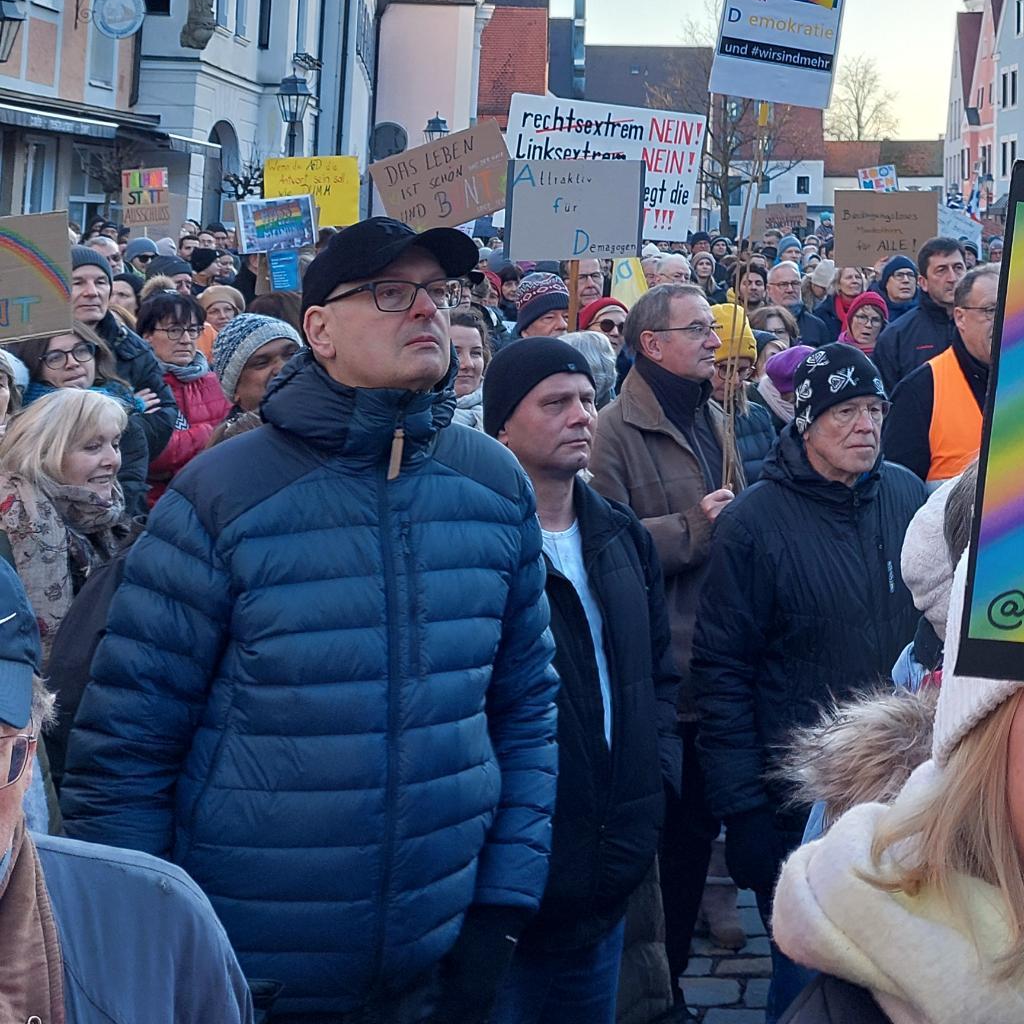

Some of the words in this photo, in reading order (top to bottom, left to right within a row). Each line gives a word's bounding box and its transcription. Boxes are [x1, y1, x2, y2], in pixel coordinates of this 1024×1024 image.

[724, 42, 748, 56] und
[751, 46, 830, 70] #wirsindmehr
[521, 106, 644, 141] rechtsextrem
[648, 117, 703, 146] NEIN!
[384, 158, 418, 187] DAS
[425, 135, 475, 171] LEBEN
[400, 182, 421, 201] IST
[429, 164, 464, 190] SCHÖN
[670, 179, 690, 206] die
[400, 202, 427, 223] UND
[552, 196, 578, 214] für
[573, 229, 637, 256] Demagogen
